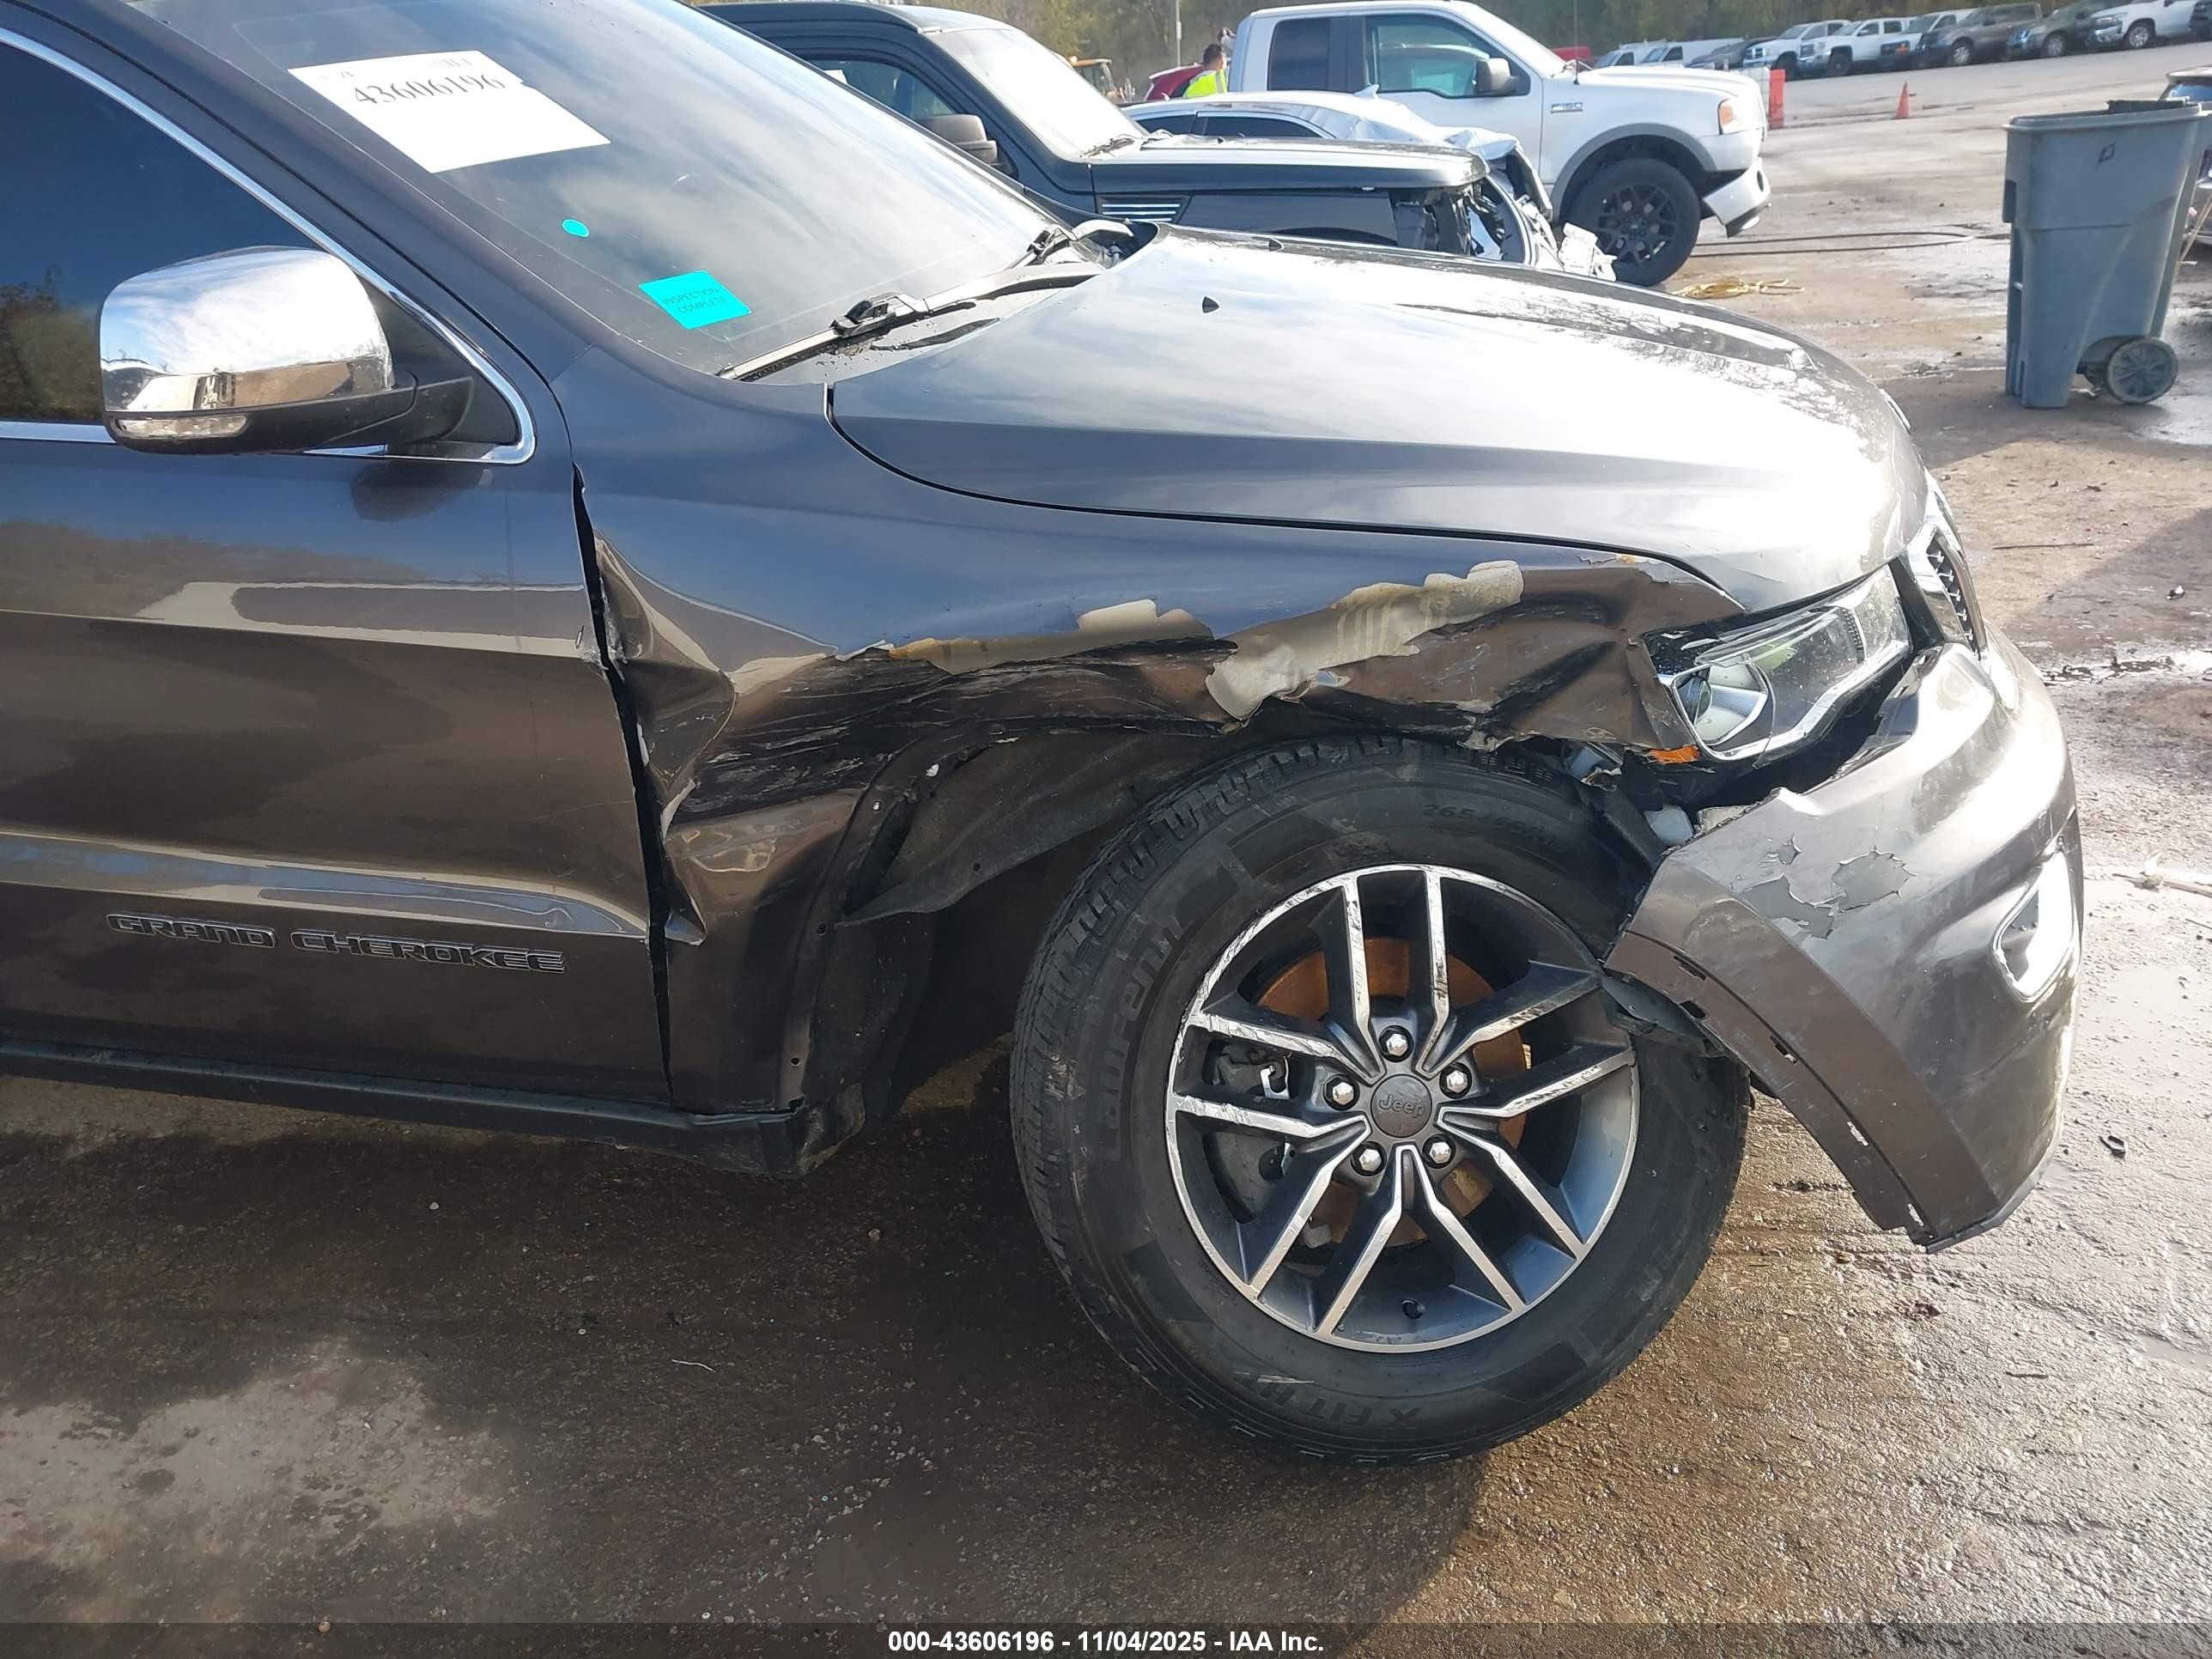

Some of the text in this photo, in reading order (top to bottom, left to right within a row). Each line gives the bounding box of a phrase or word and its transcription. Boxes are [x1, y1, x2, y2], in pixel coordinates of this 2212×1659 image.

[354, 74, 506, 104] 43606196
[661, 287, 720, 305] INSPECTION
[677, 295, 729, 314] COMPLETE
[106, 913, 567, 974] GRAND CHEROKEE
[1378, 1093, 1424, 1117] Jeep
